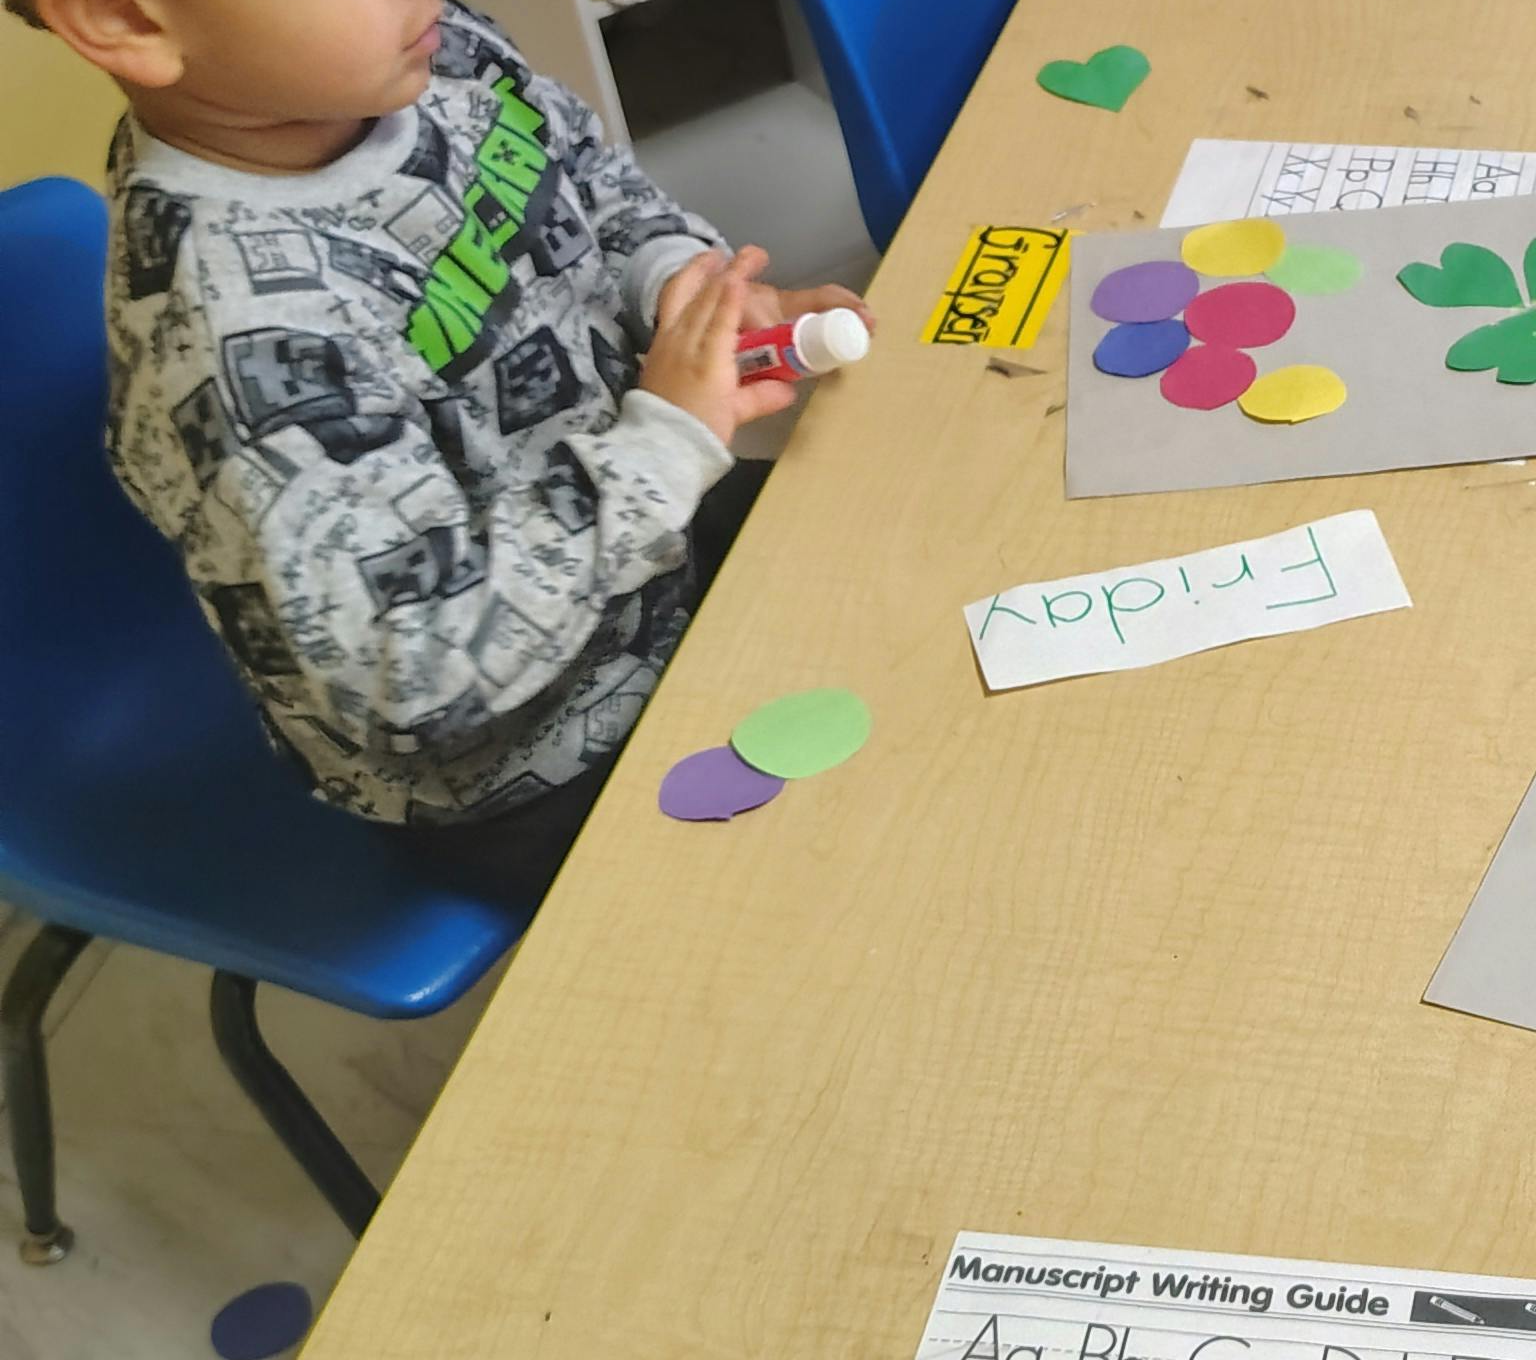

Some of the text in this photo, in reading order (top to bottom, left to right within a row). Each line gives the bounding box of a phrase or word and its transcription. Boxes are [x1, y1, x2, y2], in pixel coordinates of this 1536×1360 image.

[1280, 154, 1331, 177] Xx
[1337, 157, 1394, 182] Pp
[1408, 160, 1457, 185] Hh
[1472, 163, 1520, 194] Aa
[978, 526, 1336, 645] Friday
[948, 1254, 1391, 1318] Manuscript Writing Guide
